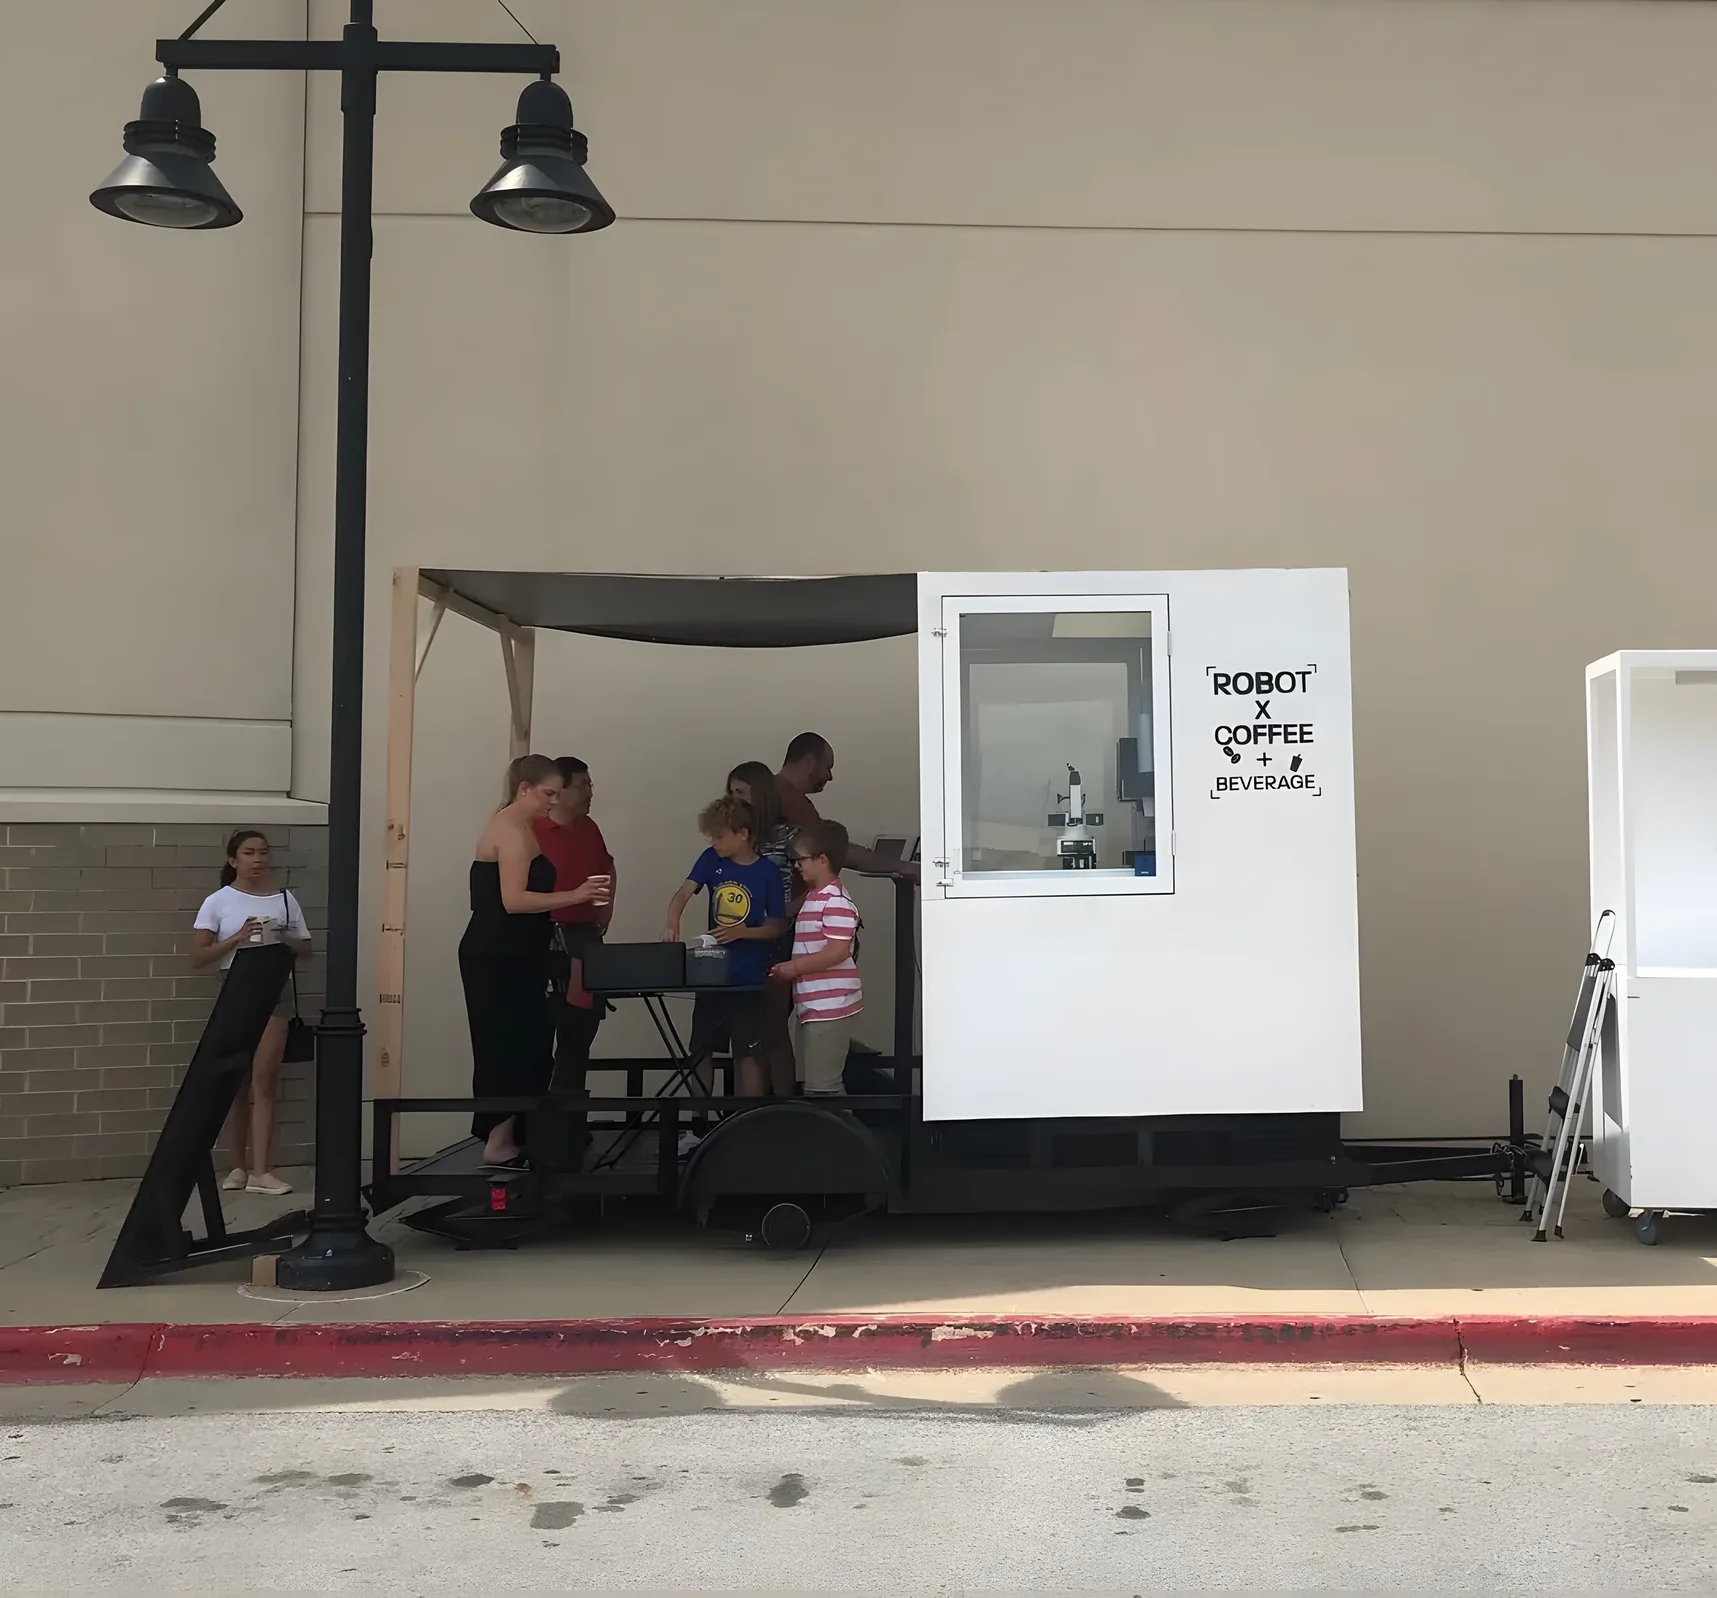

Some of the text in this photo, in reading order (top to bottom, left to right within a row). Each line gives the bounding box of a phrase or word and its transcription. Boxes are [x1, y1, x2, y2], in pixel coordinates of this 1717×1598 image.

[1213, 671, 1312, 695] ROBOT
[1255, 700, 1271, 719] X
[1215, 724, 1314, 745] COFFEE
[1216, 774, 1315, 791] BEVERAGE
[727, 892, 743, 904] 30
